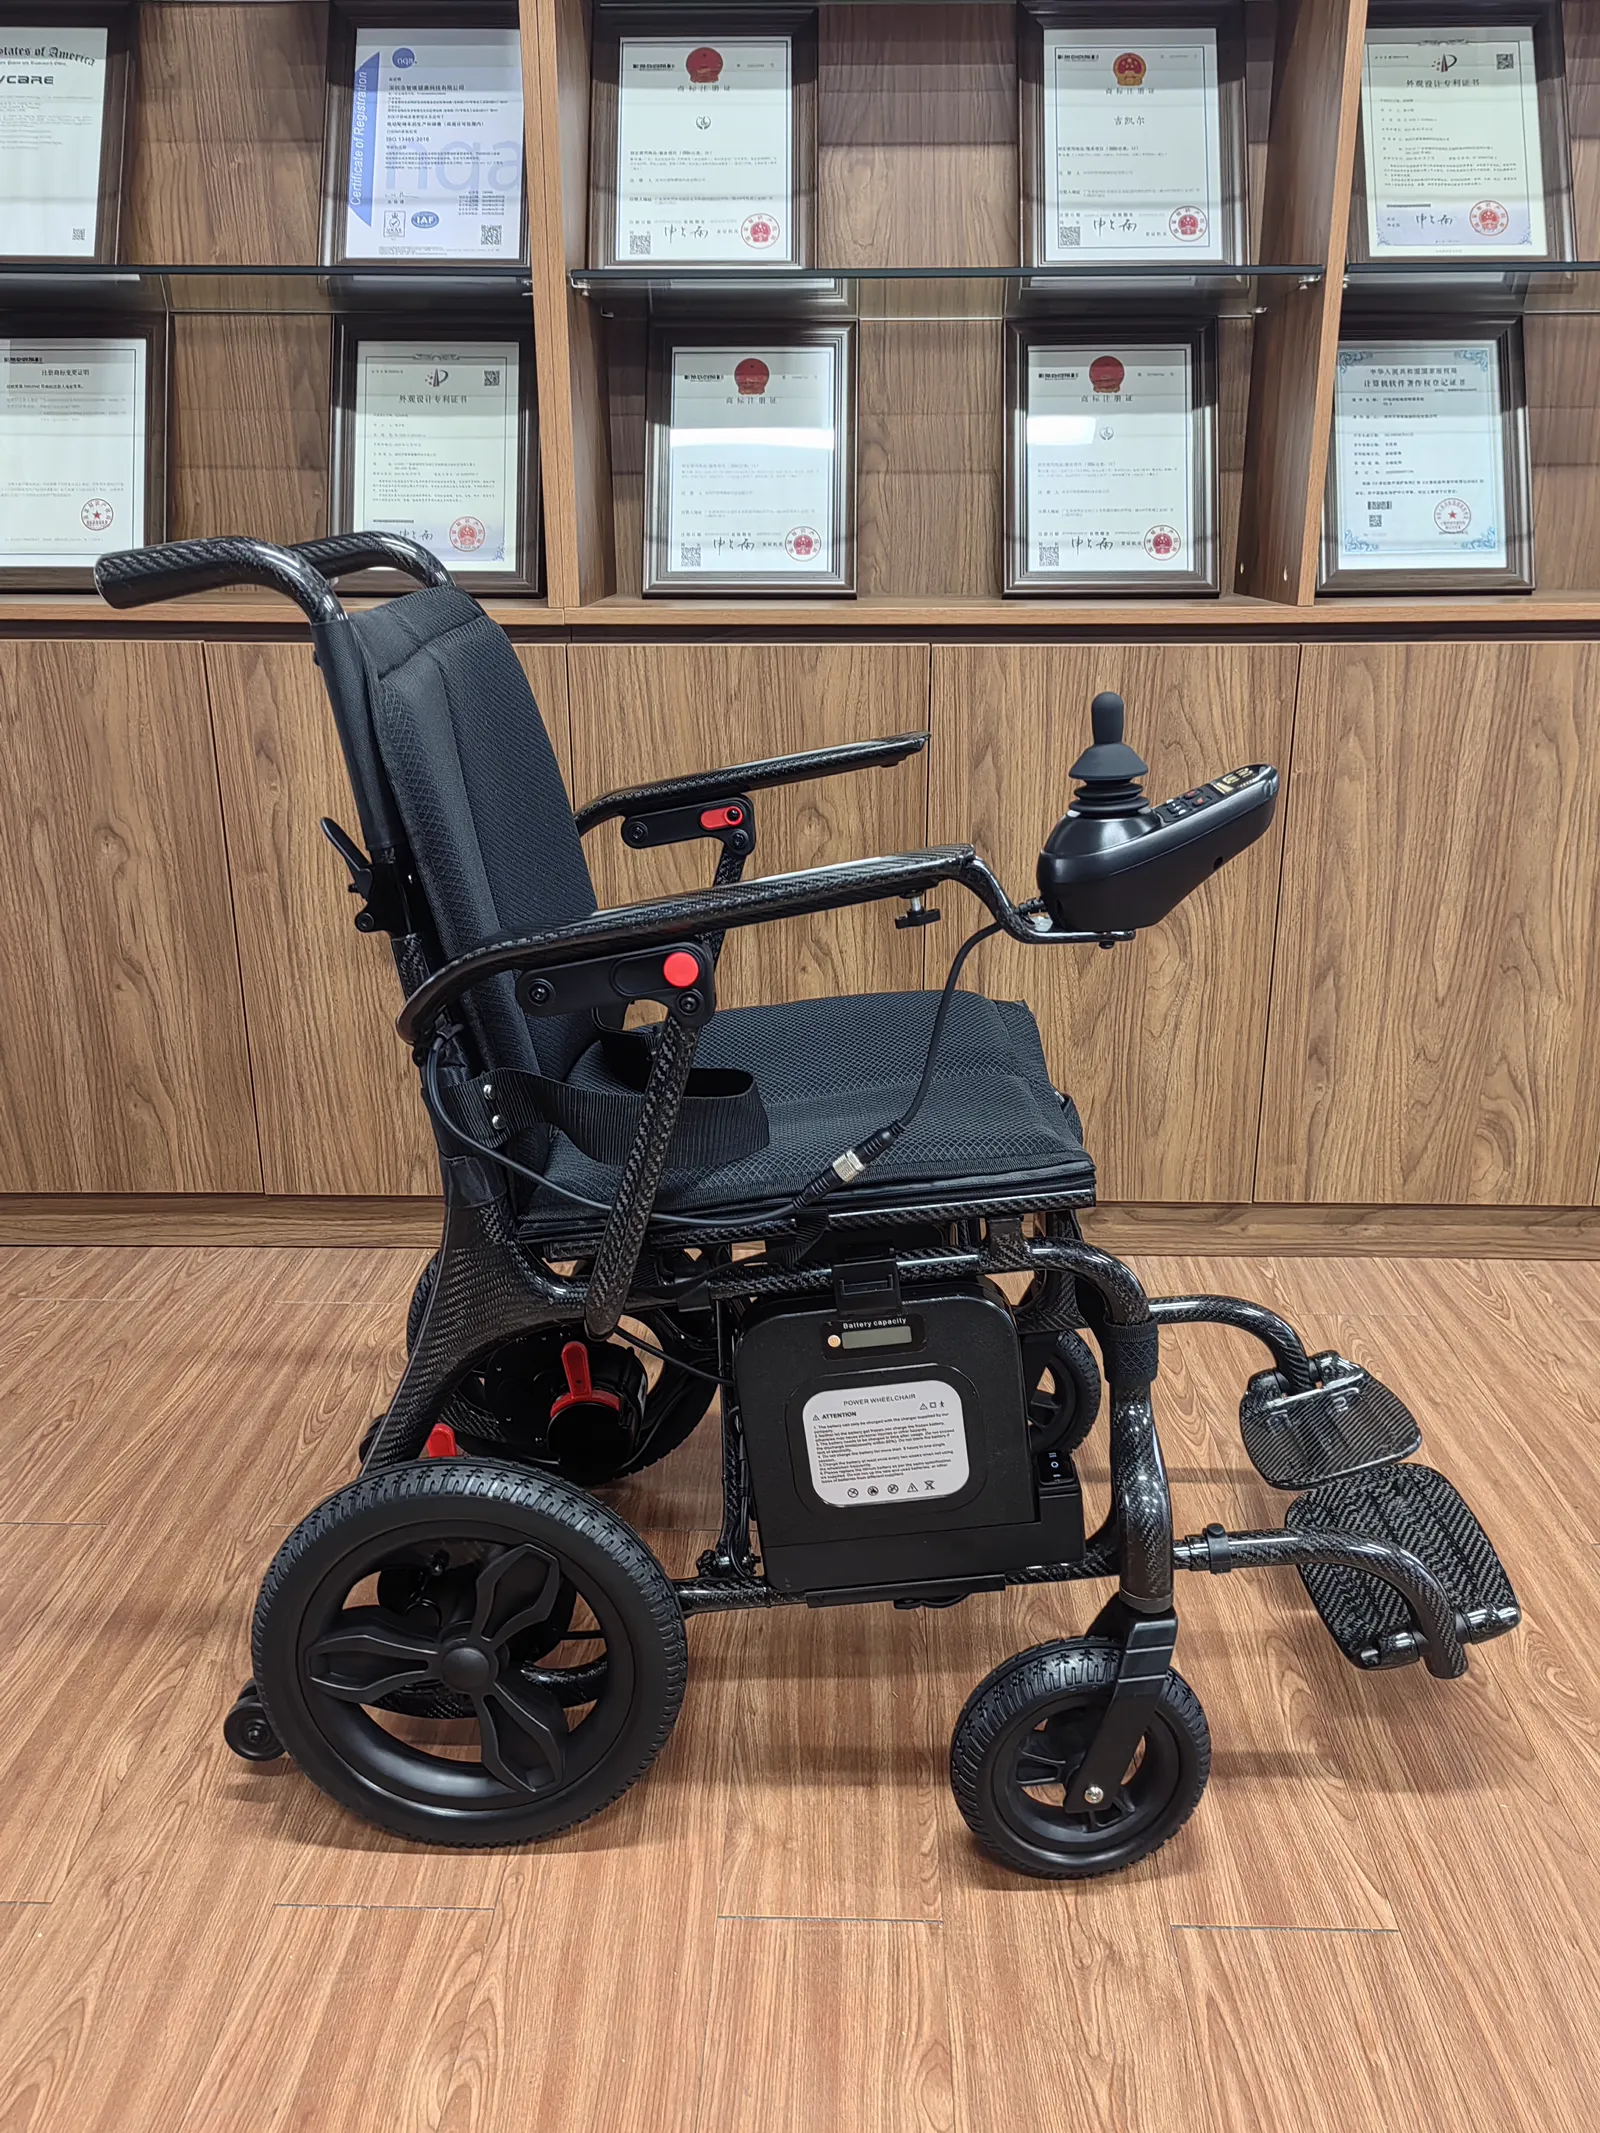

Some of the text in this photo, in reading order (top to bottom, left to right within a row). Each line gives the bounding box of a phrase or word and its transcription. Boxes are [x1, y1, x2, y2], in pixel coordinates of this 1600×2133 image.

[34, 46, 46, 57] of
[49, 46, 96, 67] America
[1406, 78, 1480, 88] 外观设计专利证书
[350, 71, 368, 206] Certificate of Registration
[416, 216, 434, 224] IAF
[1364, 378, 1466, 388] 计算机软件著作权登记证书
[399, 394, 468, 404] 外观设计专利证书
[843, 1317, 907, 1330] Battery capacity
[870, 1394, 916, 1403] WHEELCHAIR
[822, 1411, 857, 1420] ATTENTION
